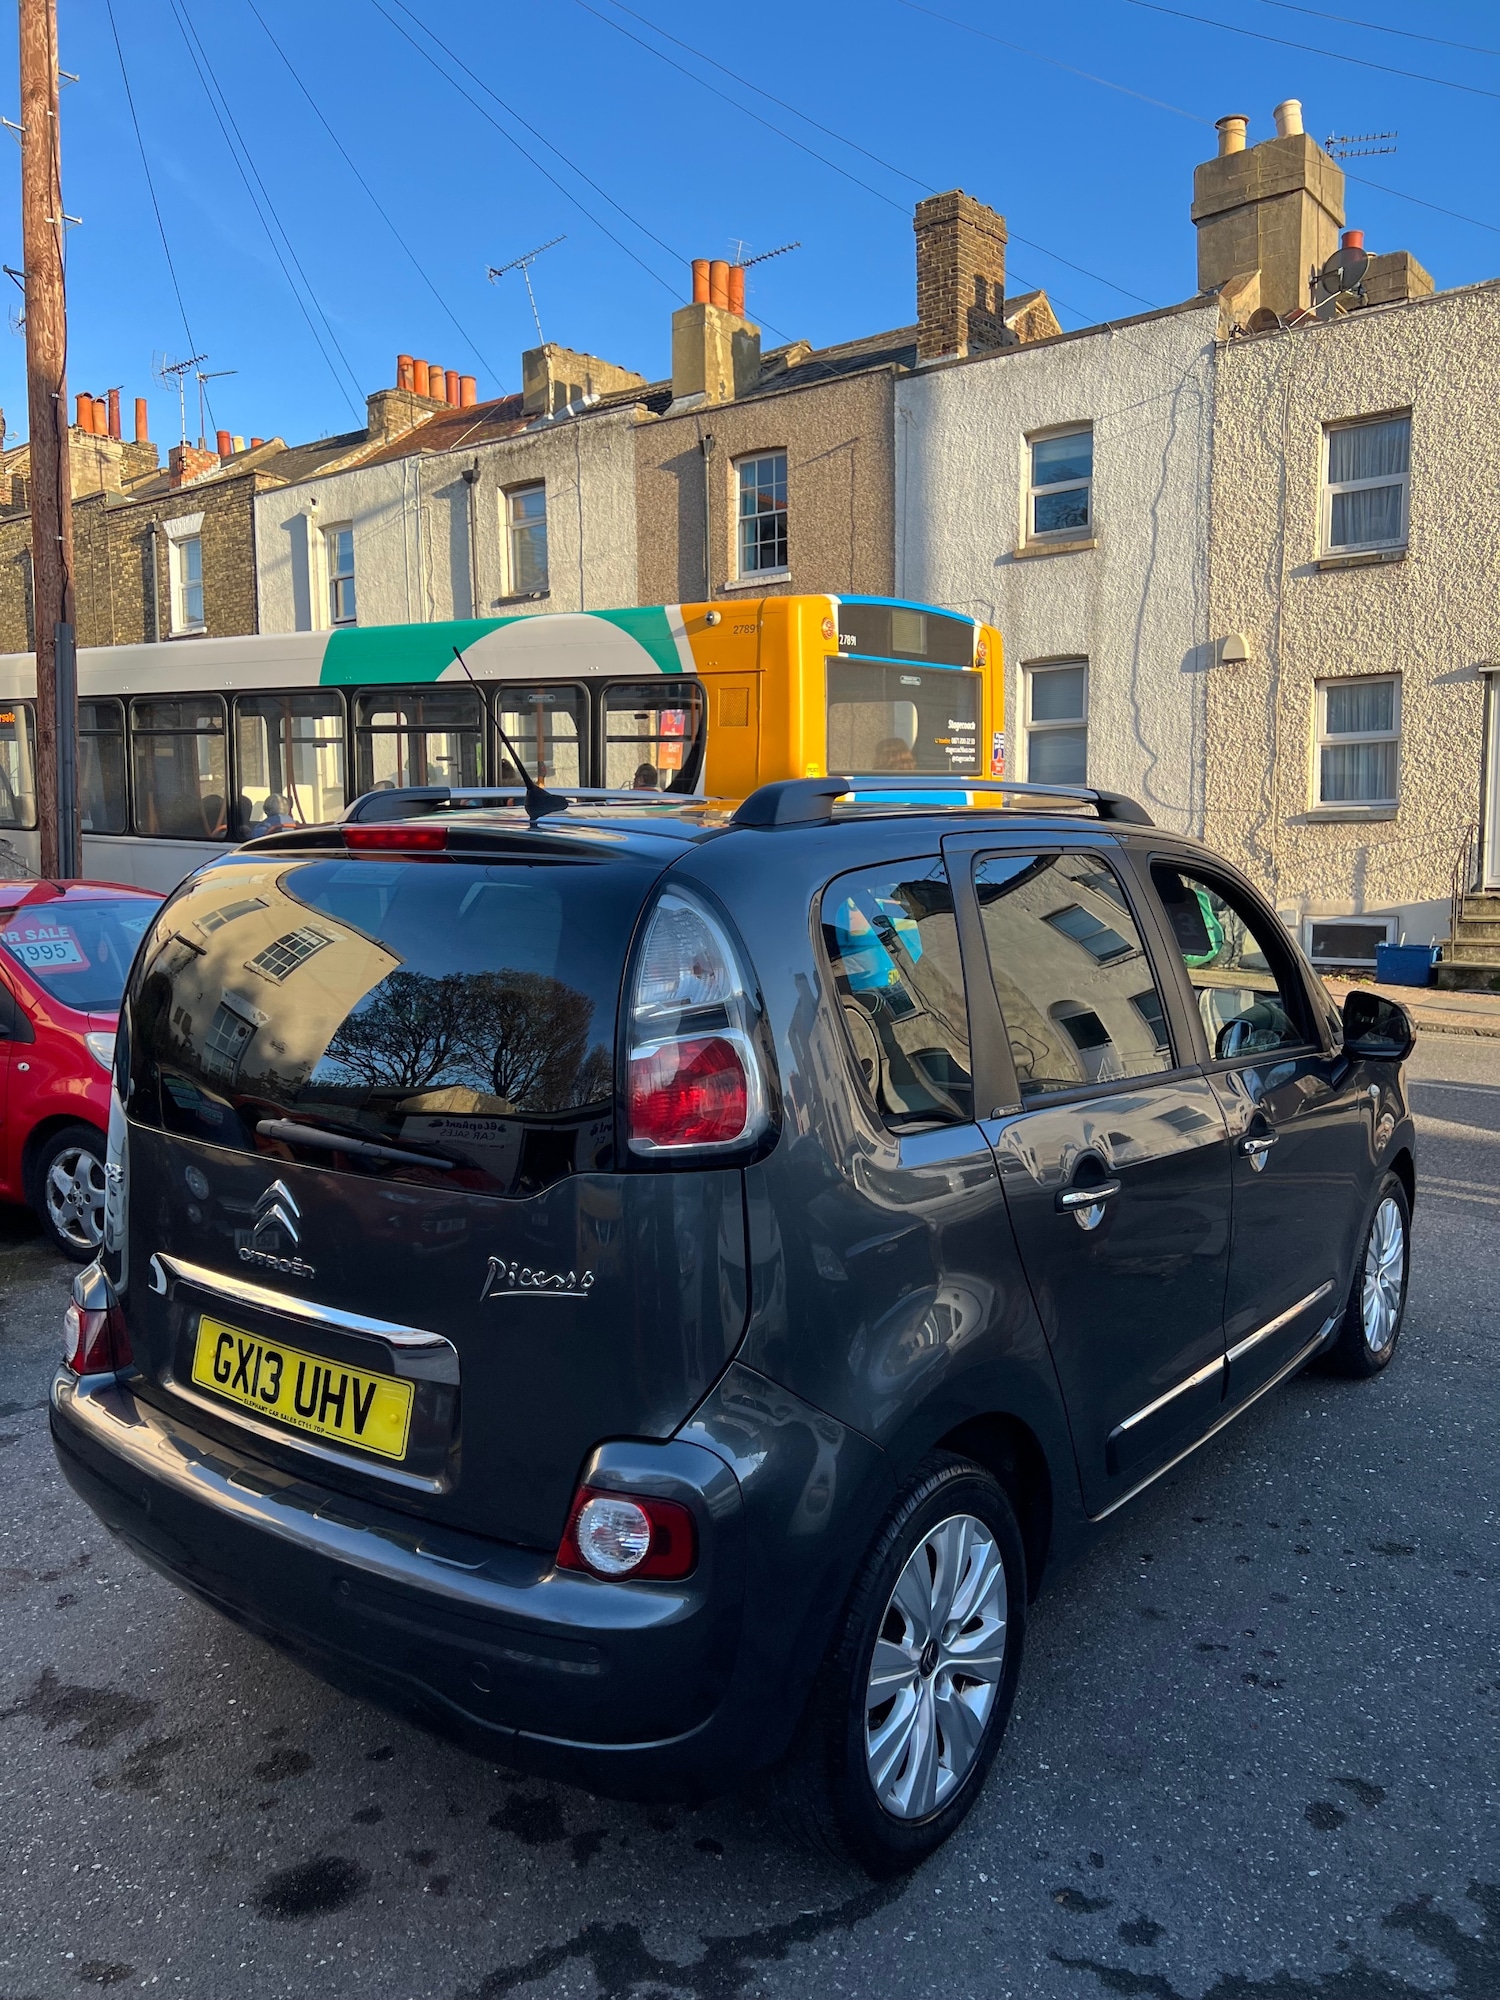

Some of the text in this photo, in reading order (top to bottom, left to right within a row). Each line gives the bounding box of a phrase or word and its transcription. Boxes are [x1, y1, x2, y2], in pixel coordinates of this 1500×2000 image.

[839, 634, 857, 646] 27891
[947, 719, 976, 732] Stagecoach
[25, 926, 70, 940] SALE
[479, 1256, 595, 1302] Picasso
[213, 1332, 378, 1436] GX13 UHV
[243, 1398, 268, 1412] ELEPHANT
[268, 1408, 279, 1417] CAR
[280, 1413, 297, 1424] SALES
[297, 1420, 312, 1430] CT11
